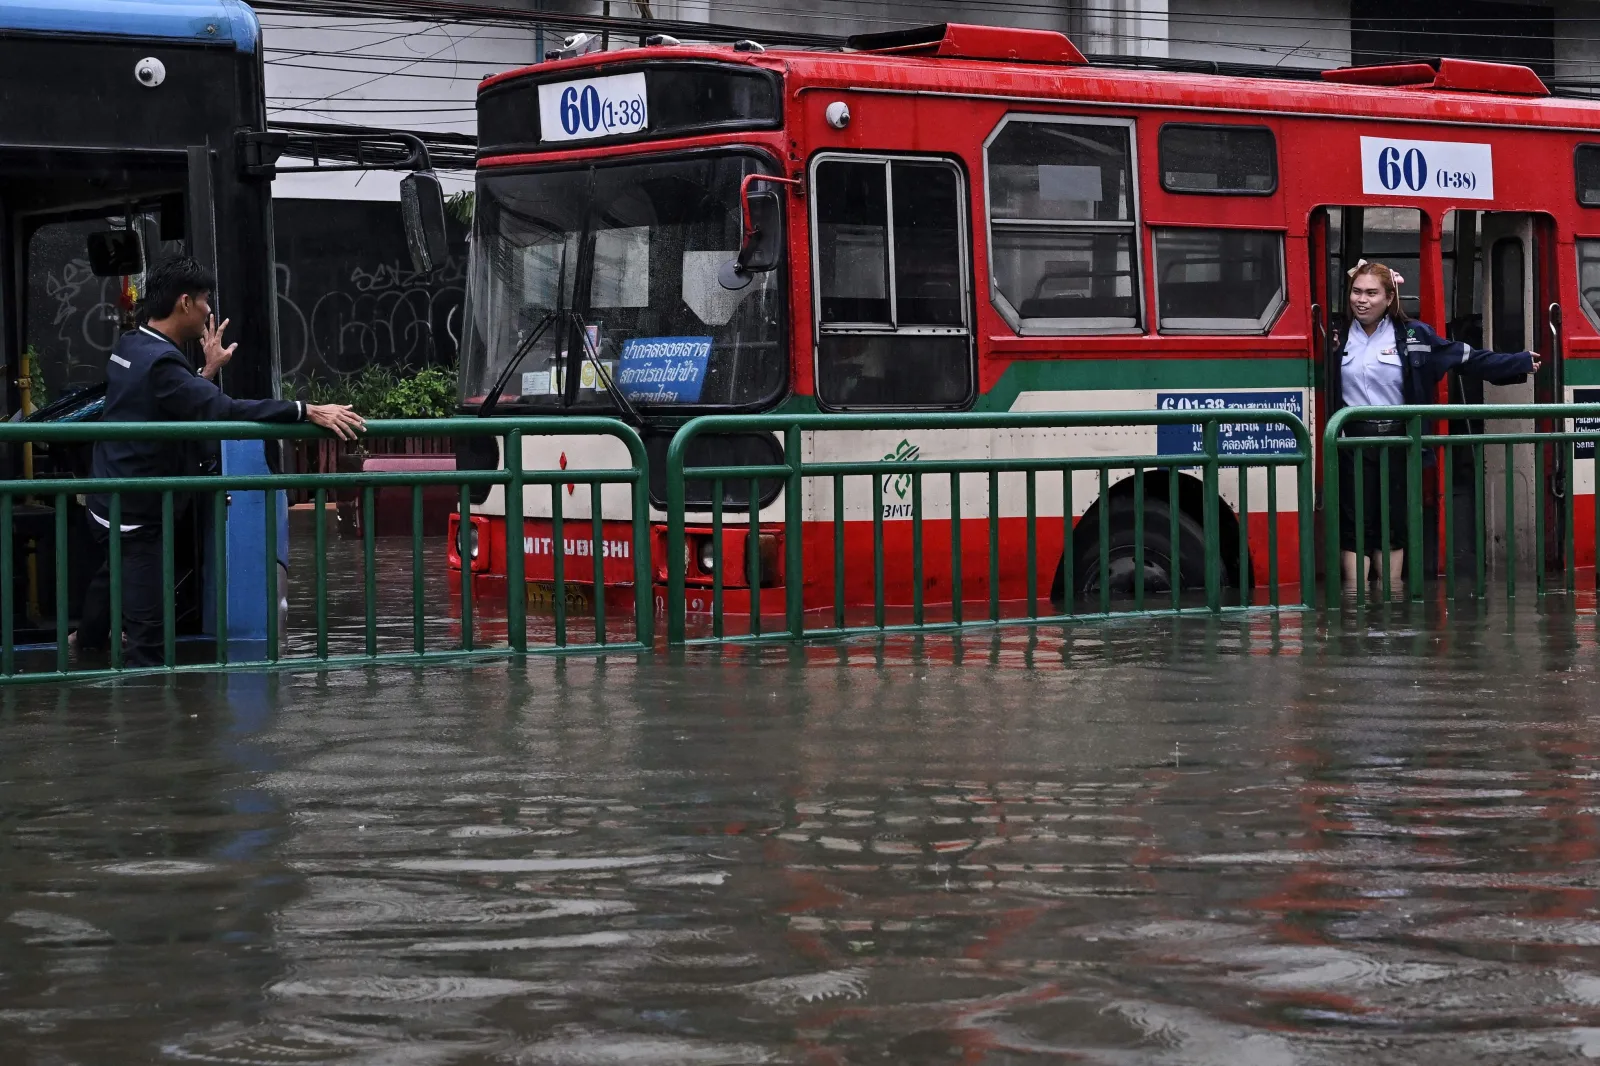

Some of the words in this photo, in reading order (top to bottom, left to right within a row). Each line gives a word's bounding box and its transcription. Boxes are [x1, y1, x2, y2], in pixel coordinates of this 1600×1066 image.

[560, 86, 601, 135] 60
[1378, 147, 1427, 191] 60
[1436, 168, 1476, 191] (1-38)
[623, 341, 711, 359] ปากคลองตลาด
[620, 360, 699, 384] สถานีรถไฟฟ้า
[1222, 436, 1259, 451] คลองตัน
